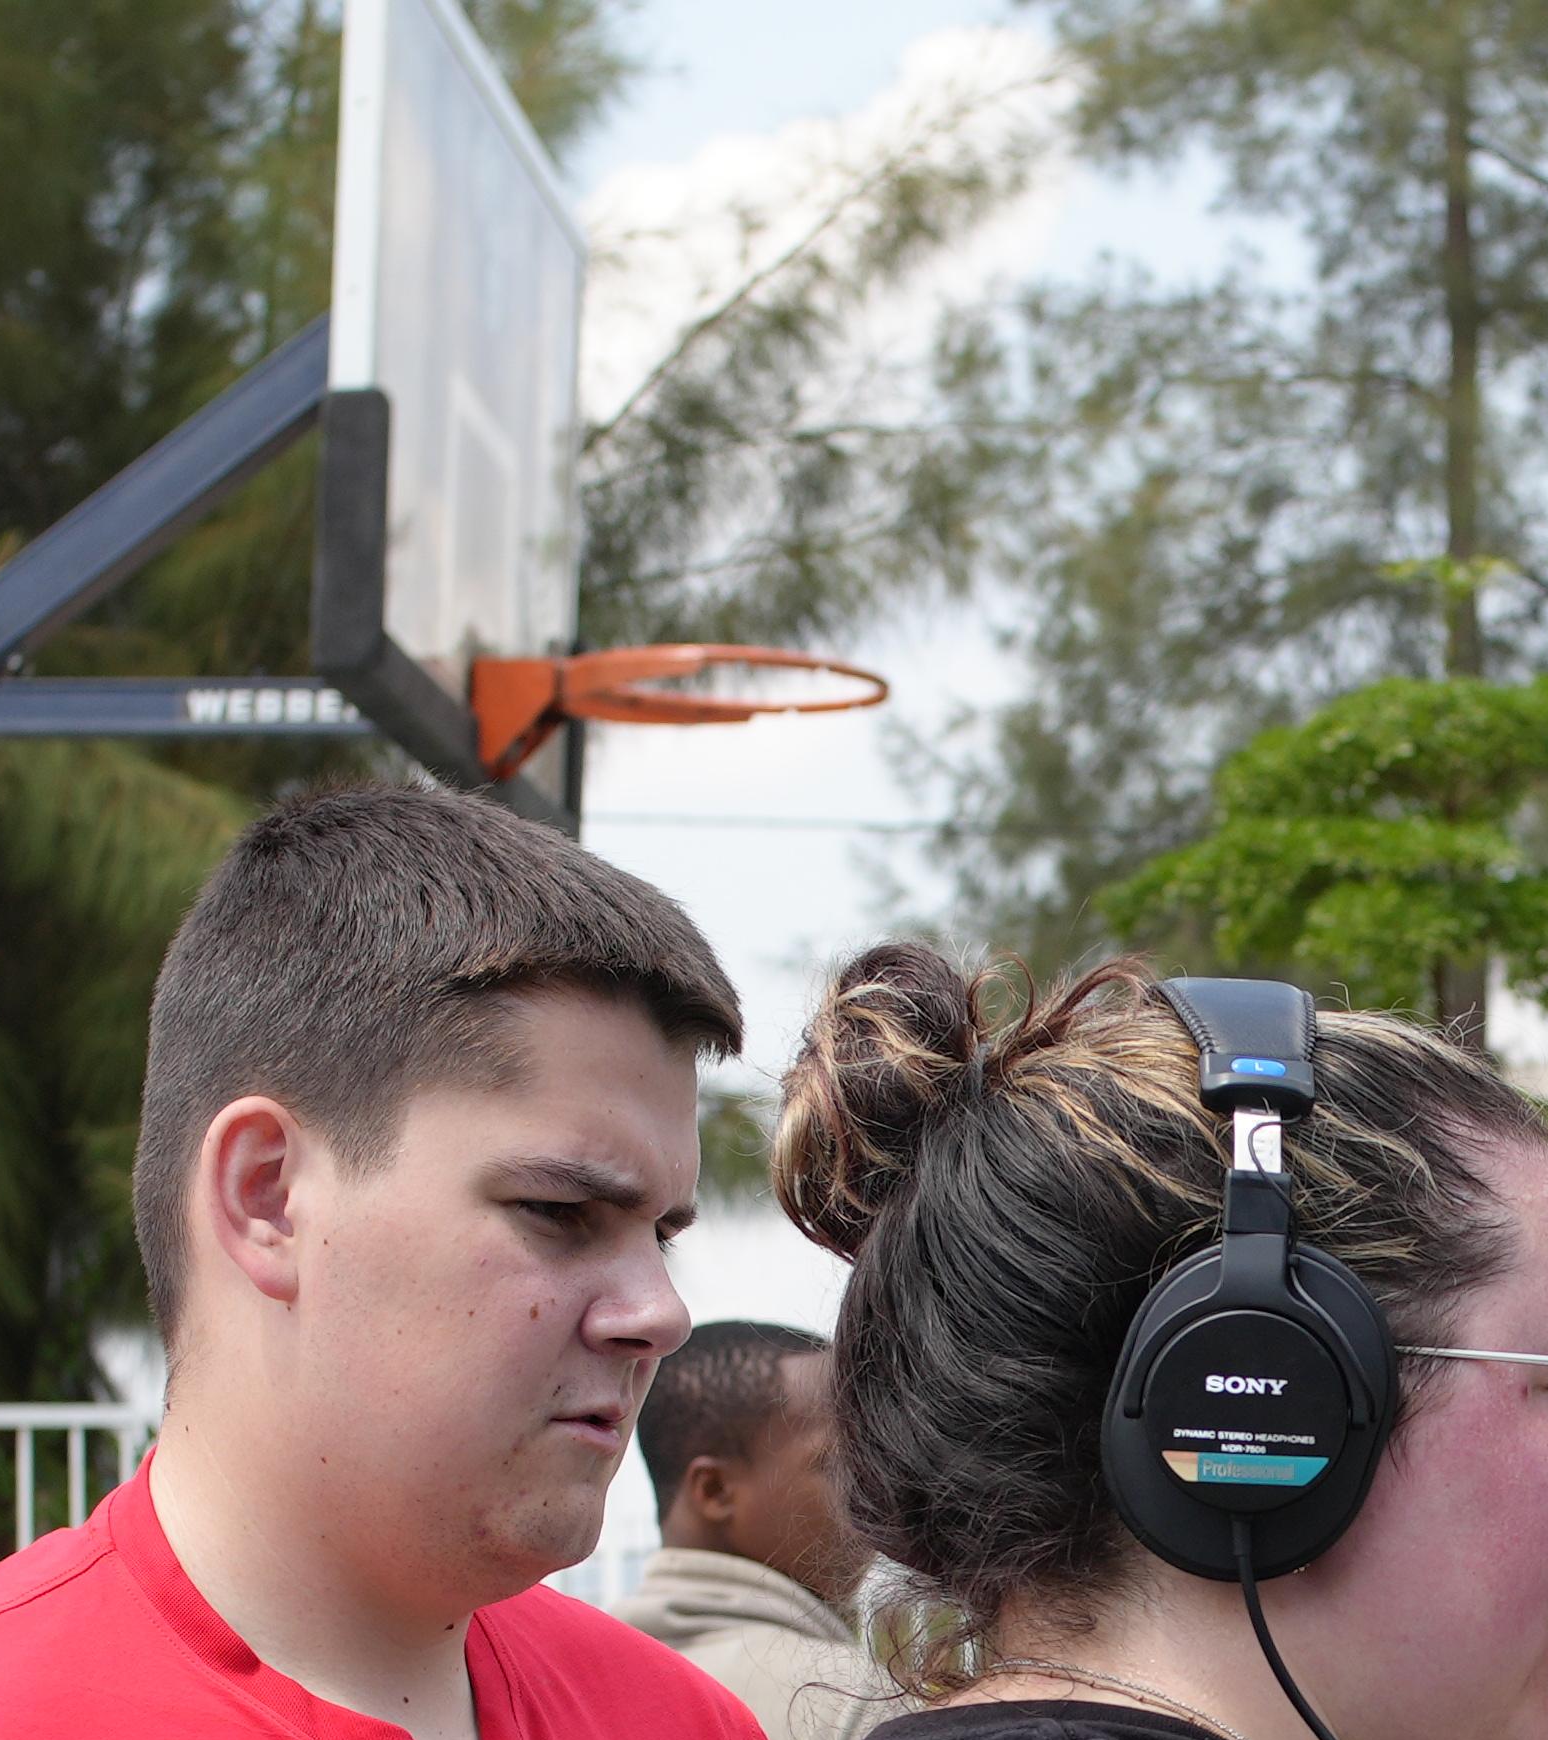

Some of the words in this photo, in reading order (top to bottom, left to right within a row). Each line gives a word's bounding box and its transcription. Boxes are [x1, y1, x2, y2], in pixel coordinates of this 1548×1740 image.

[1254, 1062, 1264, 1072] L
[1205, 1375, 1288, 1395] SONY
[1173, 1428, 1216, 1440] DYNAMIC
[1218, 1430, 1253, 1442] STEREO
[1255, 1432, 1316, 1445] HEADPHONES
[1203, 1459, 1295, 1481] Professional
